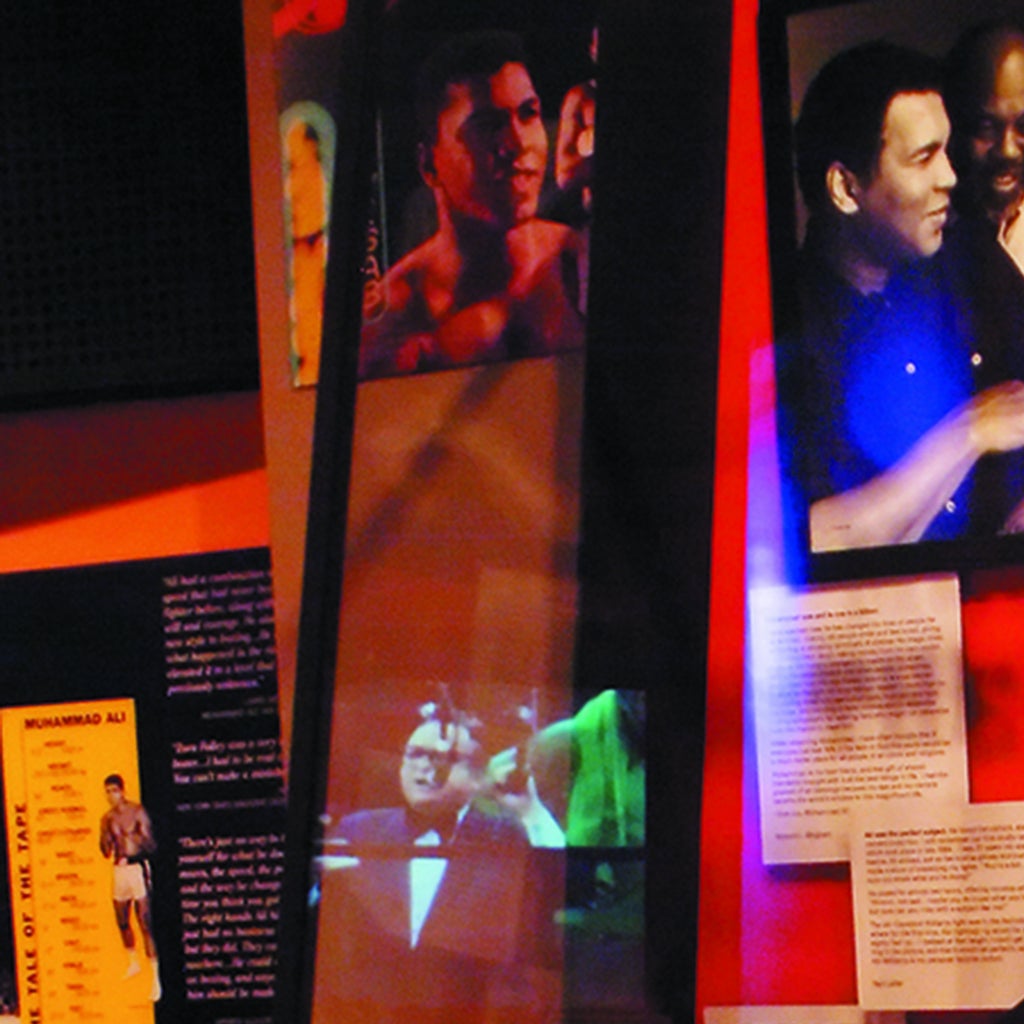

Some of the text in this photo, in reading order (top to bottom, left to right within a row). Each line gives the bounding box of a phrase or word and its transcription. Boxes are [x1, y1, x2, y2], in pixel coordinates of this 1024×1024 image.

[25, 711, 126, 730] MUHAMMAD ALI
[14, 802, 30, 854] TAPE
[20, 864, 32, 900] THE
[22, 913, 36, 937] OF
[25, 949, 39, 996] TALE
